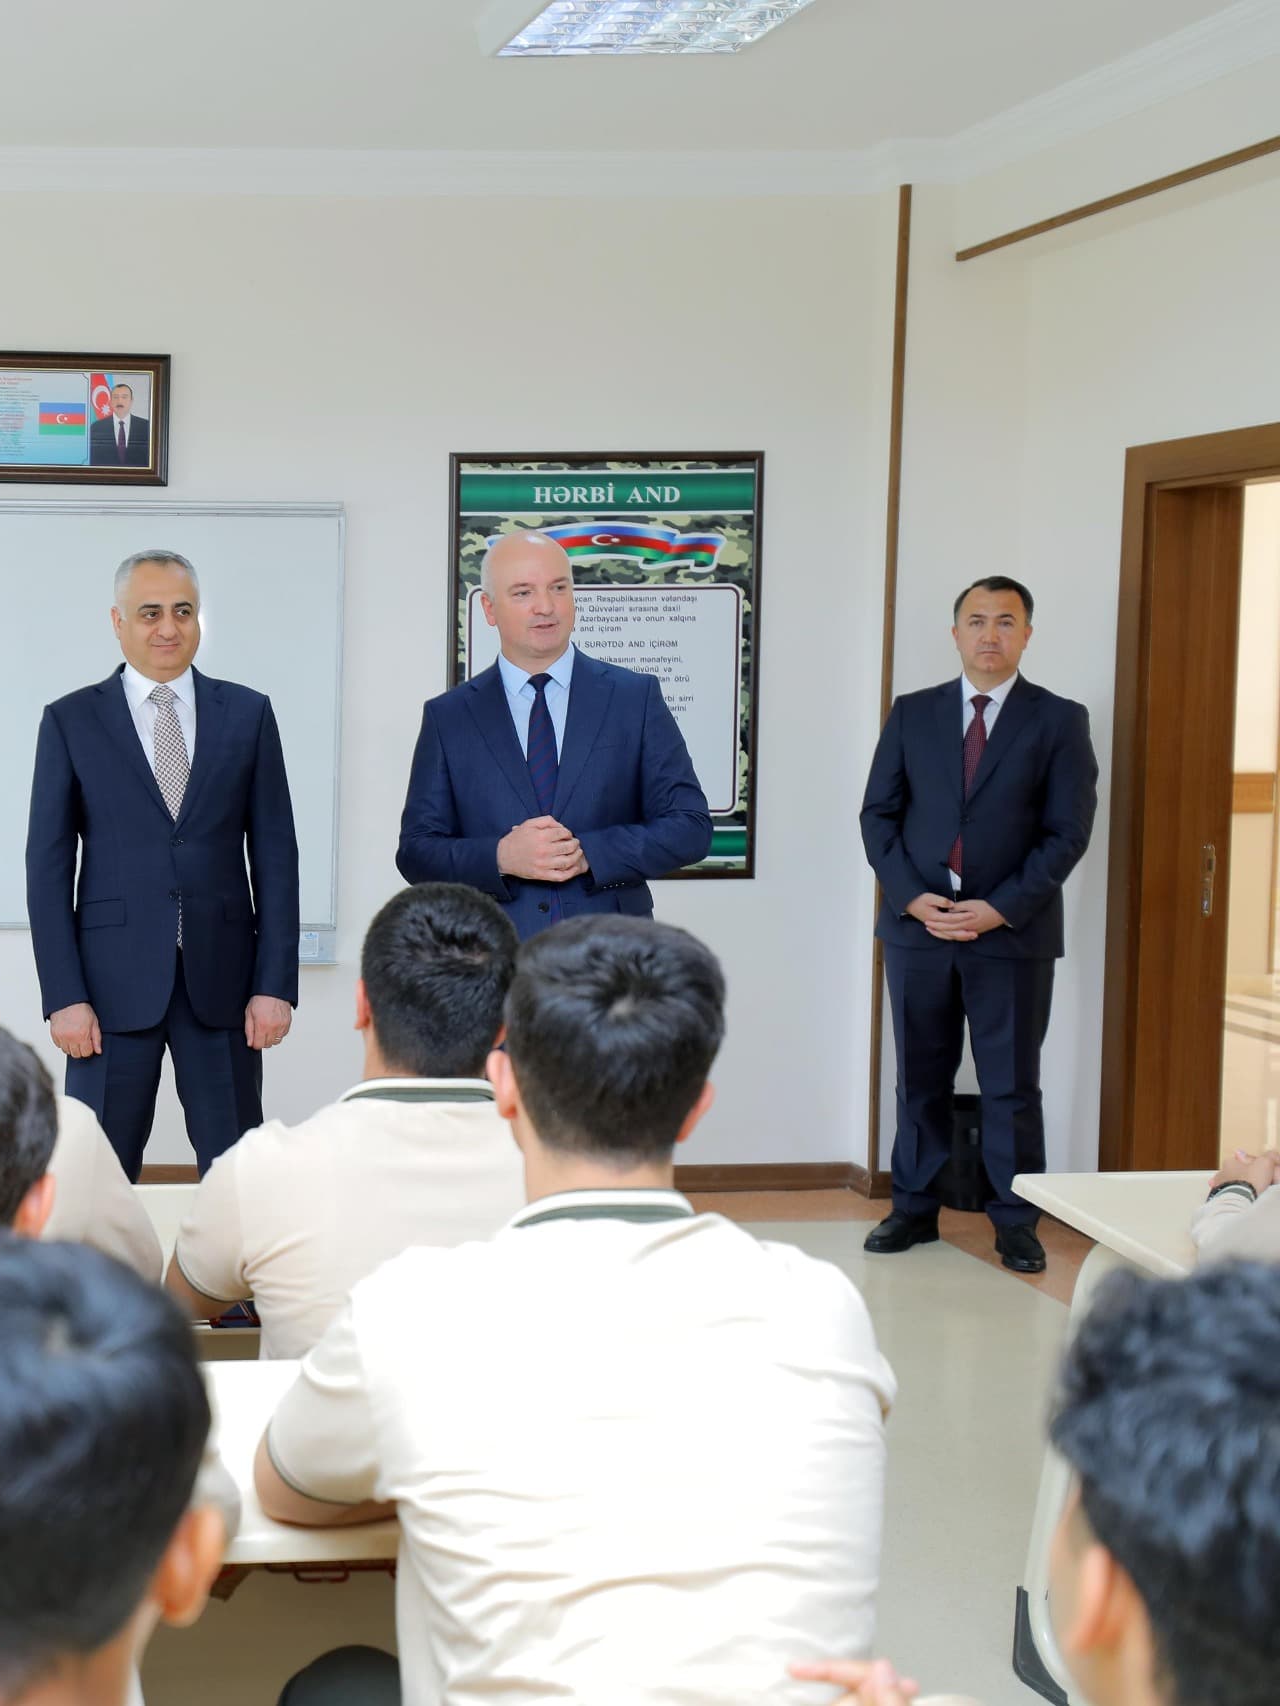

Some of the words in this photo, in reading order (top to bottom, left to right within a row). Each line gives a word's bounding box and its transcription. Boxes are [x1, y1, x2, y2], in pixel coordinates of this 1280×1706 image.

[532, 481, 616, 504] HƏRBİ
[625, 486, 681, 504] AND
[662, 604, 681, 612] daxil
[579, 624, 594, 632] and
[628, 640, 646, 648] AND
